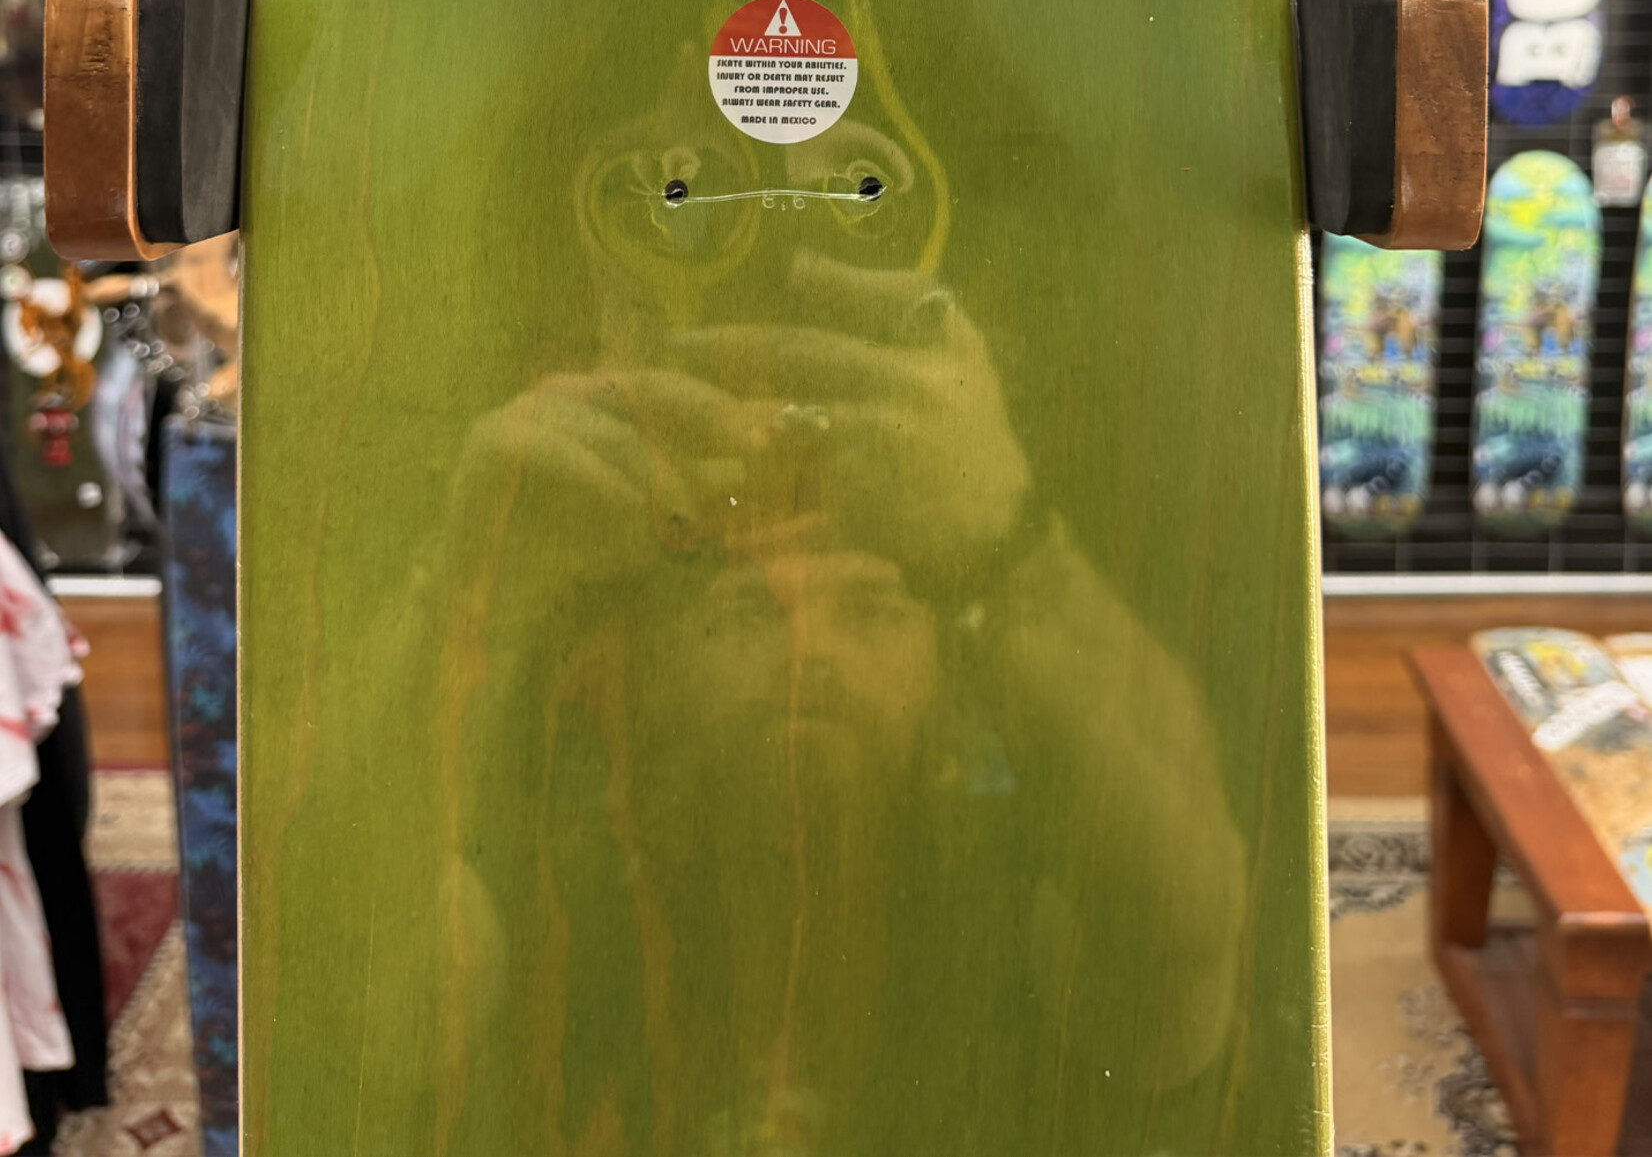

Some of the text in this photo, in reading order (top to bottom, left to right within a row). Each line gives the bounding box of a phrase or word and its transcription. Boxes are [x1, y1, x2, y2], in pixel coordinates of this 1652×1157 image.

[730, 38, 836, 54] WARNING
[717, 60, 742, 68] SKATE
[779, 61, 803, 69] YOUR
[763, 73, 791, 81] DEATH
[795, 74, 813, 82] MAY
[722, 98, 840, 108] ALWAYS WEAR SAFETY GEAR.
[769, 116, 778, 124] IN
